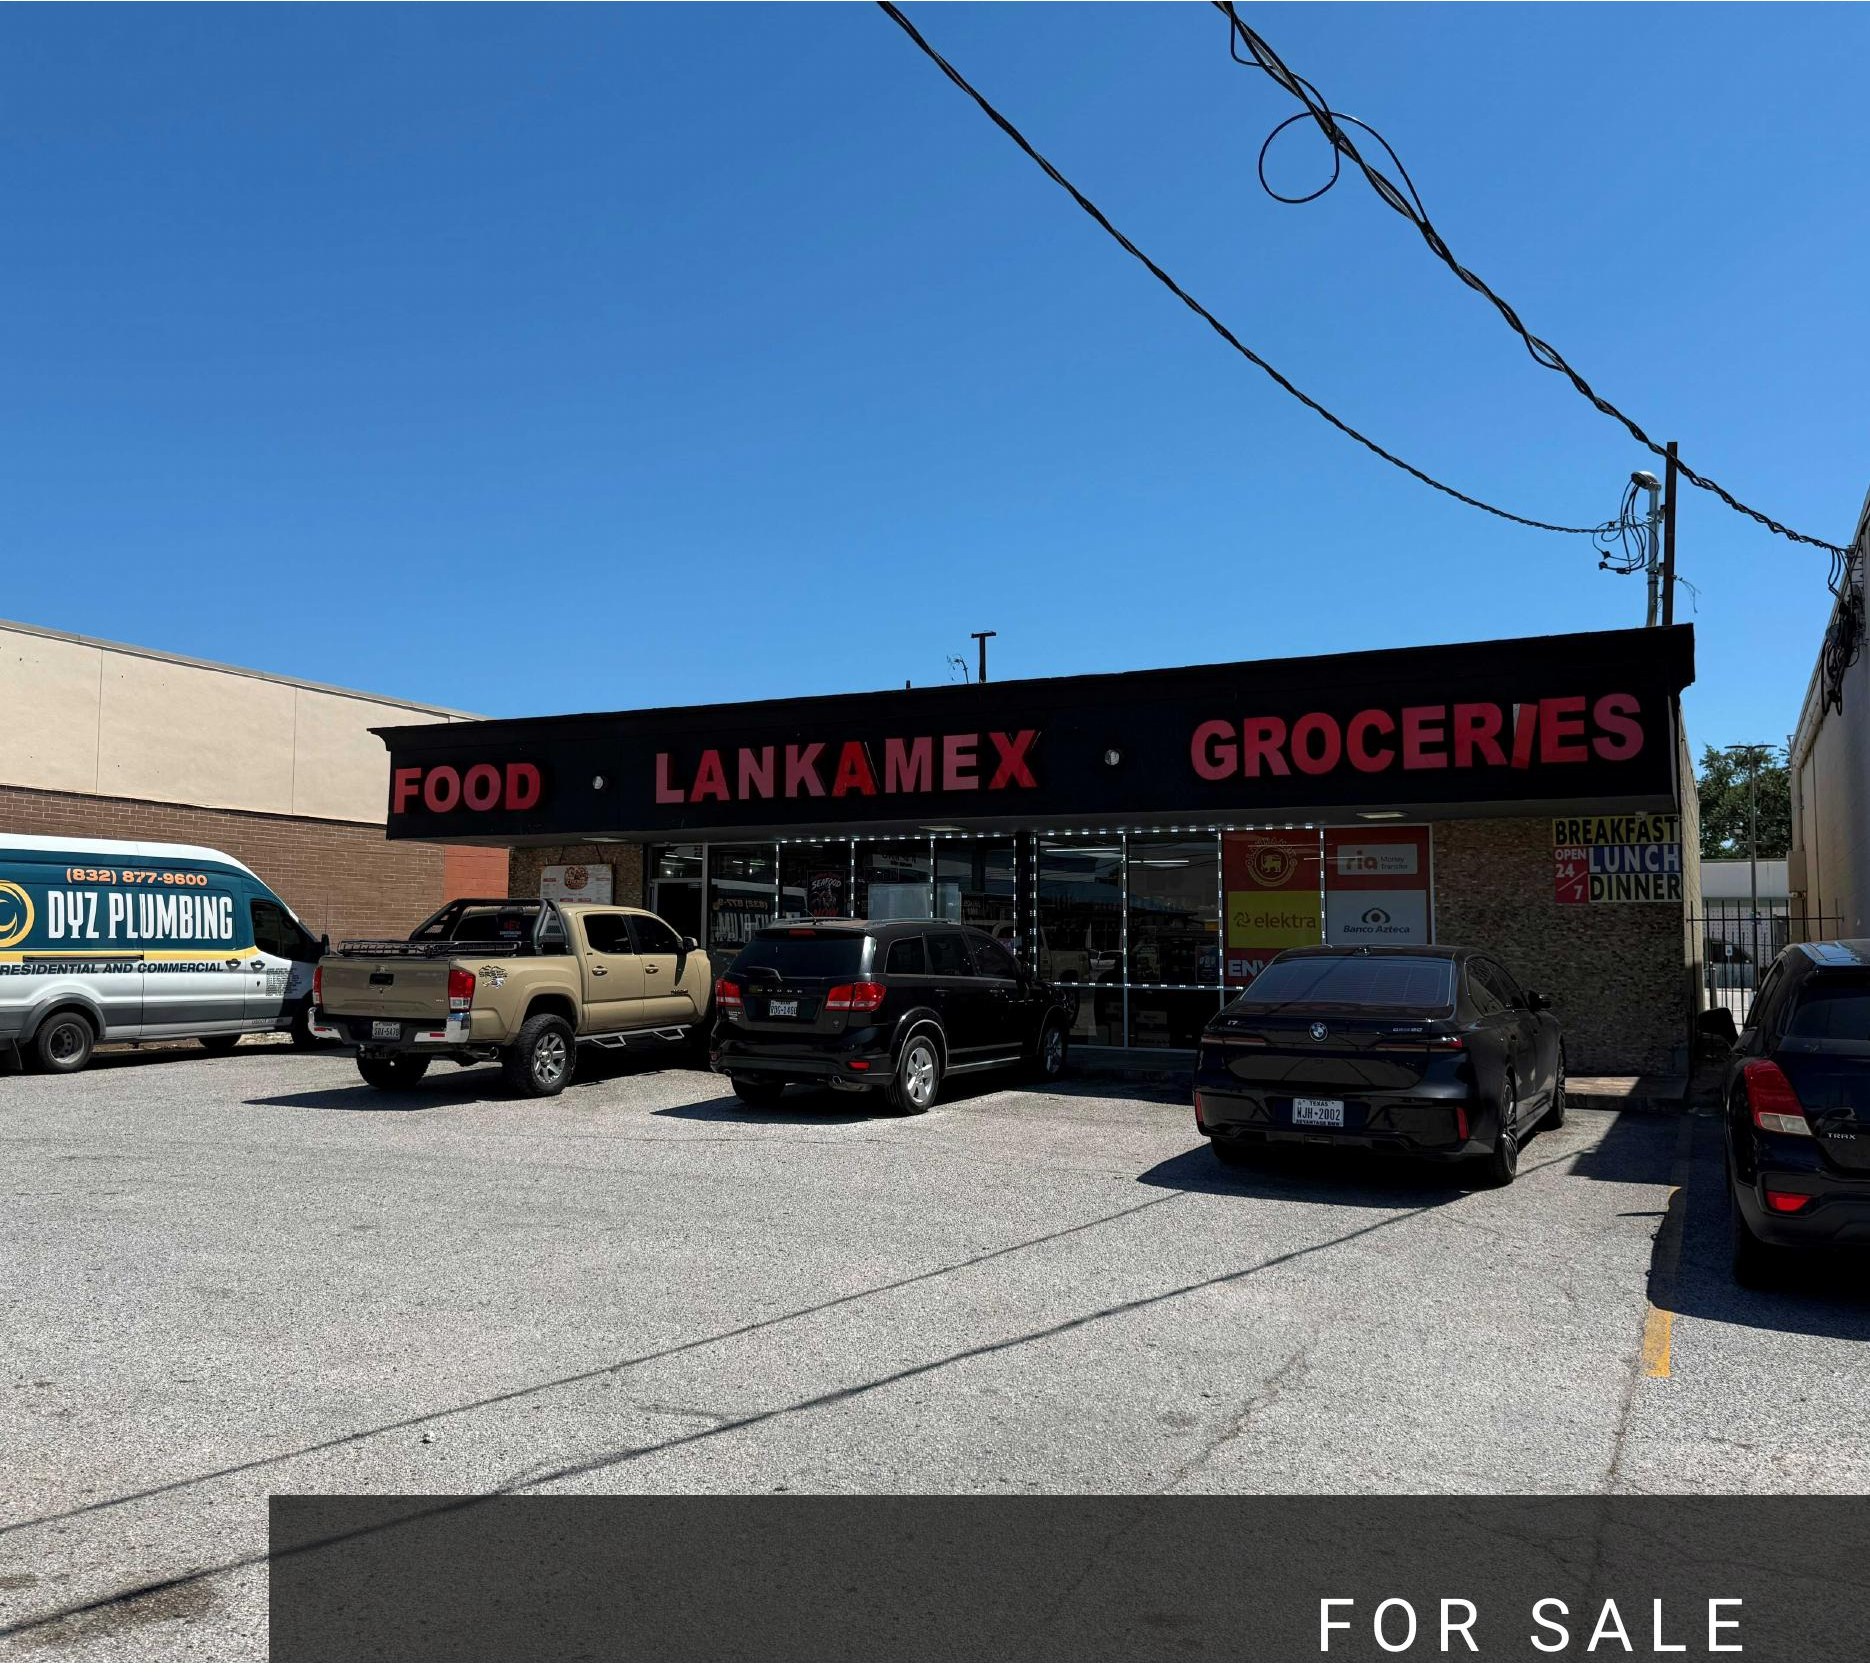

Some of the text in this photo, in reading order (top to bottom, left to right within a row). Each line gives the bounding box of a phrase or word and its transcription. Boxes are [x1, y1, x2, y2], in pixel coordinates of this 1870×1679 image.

[1191, 694, 1646, 782] GROCERIES
[655, 730, 1038, 803] LANKAMEX
[393, 763, 541, 813] FOOD
[1555, 816, 1679, 845] BREAKFAST
[1344, 849, 1378, 870] ria
[1380, 856, 1406, 864] Money
[1555, 849, 1587, 860] OPEN
[1589, 845, 1680, 873] LUNCH
[67, 868, 207, 886] (832) 877-9600
[810, 877, 842, 890] SEAFOOD
[1590, 875, 1682, 901] DINNER
[48, 890, 233, 939] DYZ PLUMBING
[1254, 912, 1317, 930] elektra
[1343, 924, 1411, 933] Banco Azteca
[0, 962, 224, 975] RESIDENTIAL AND COMMERCIAL
[1827, 1132, 1857, 1140] TRAX
